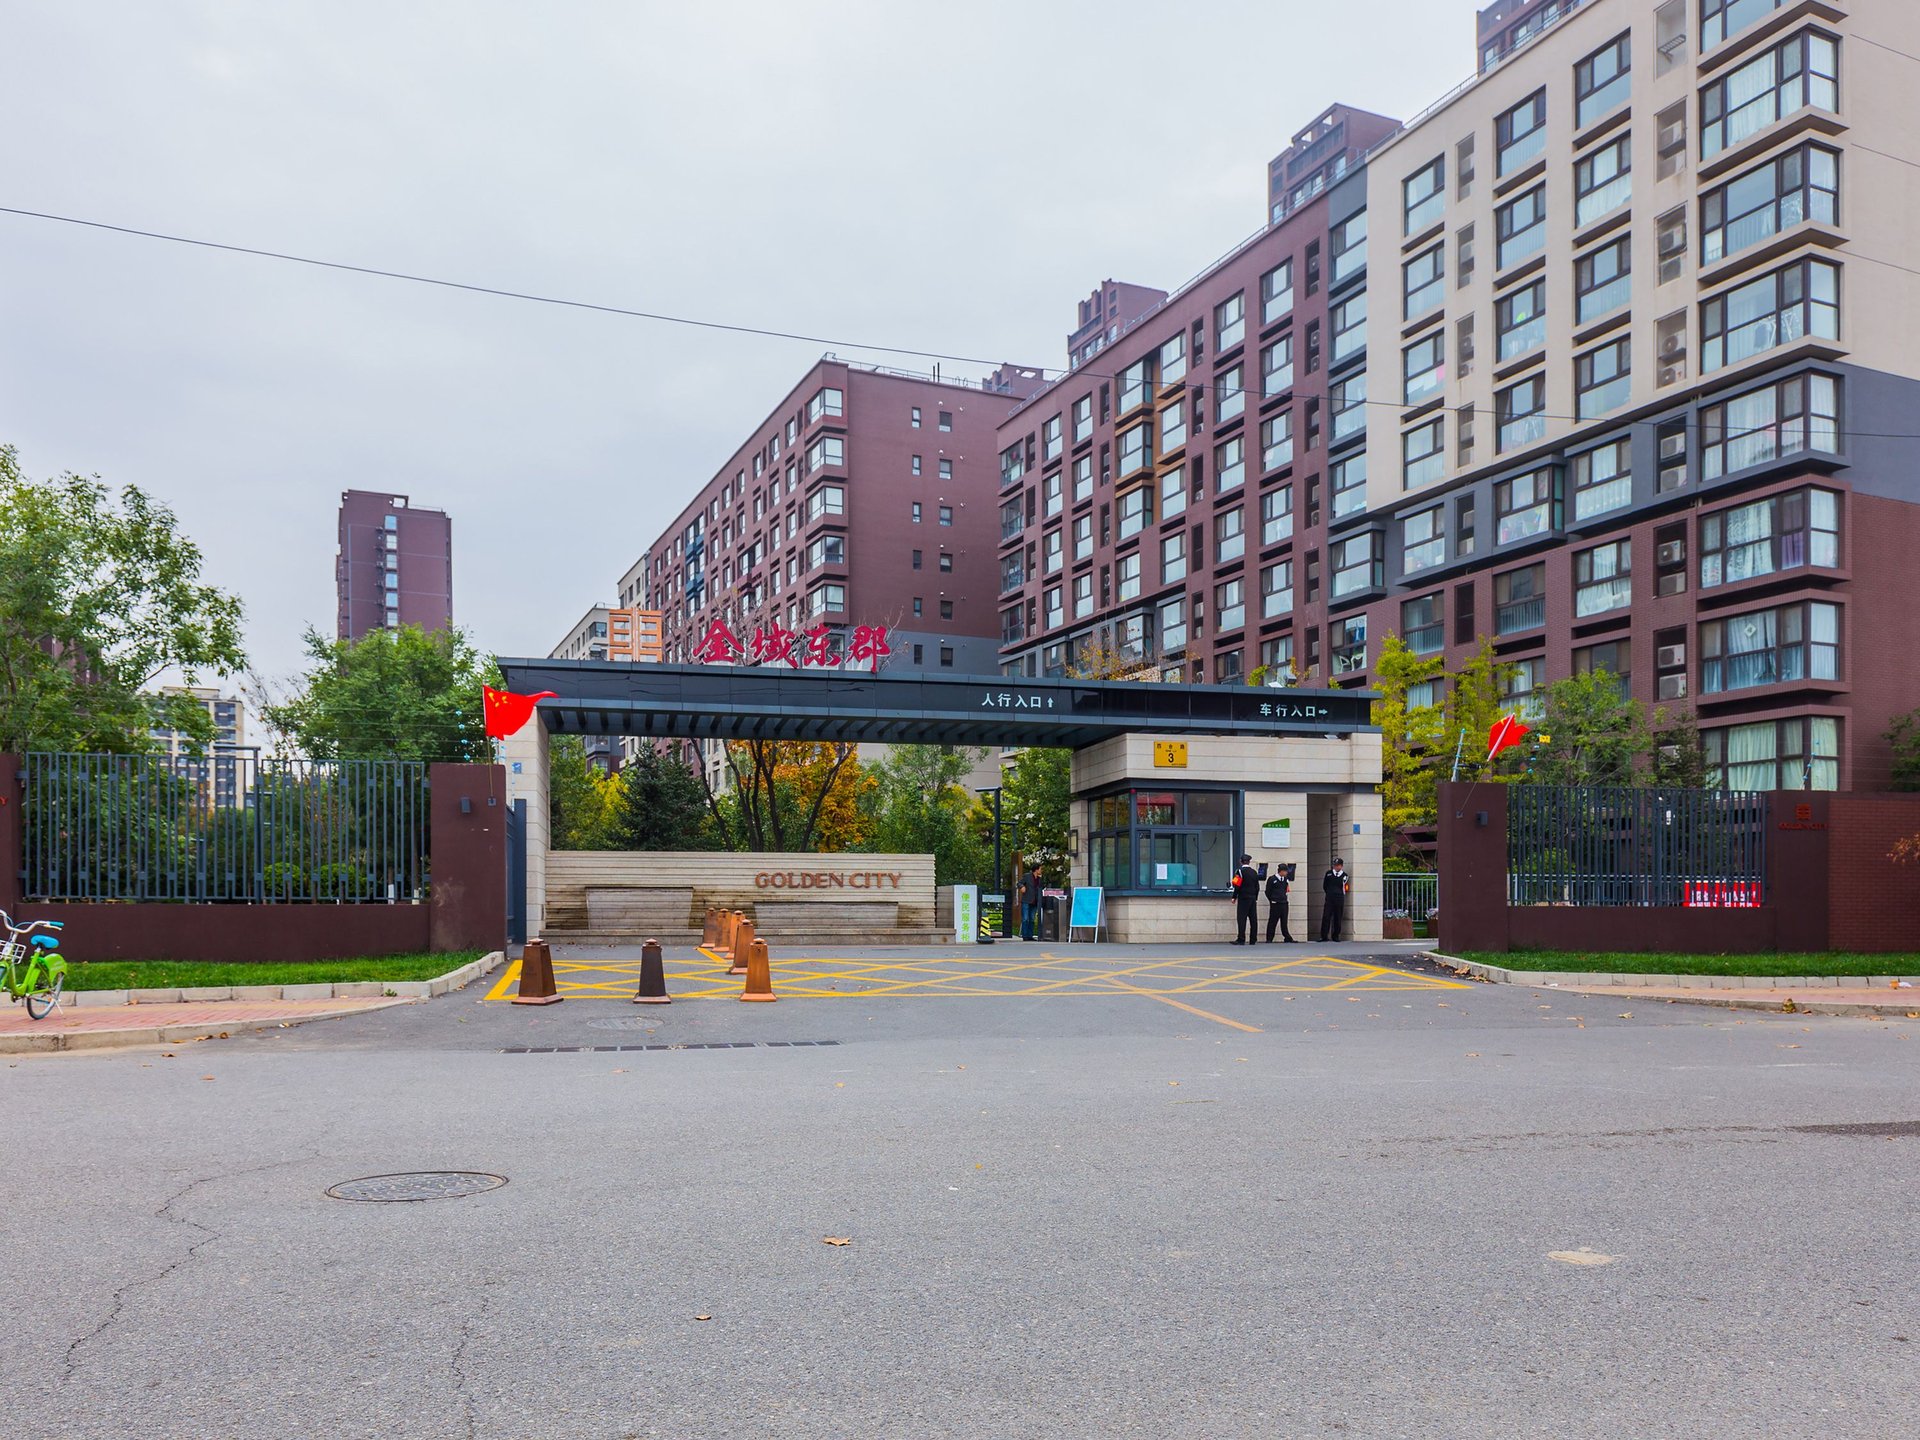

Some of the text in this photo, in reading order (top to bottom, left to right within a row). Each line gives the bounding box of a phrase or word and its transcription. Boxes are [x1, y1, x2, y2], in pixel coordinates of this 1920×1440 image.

[693, 618, 891, 674] 金域东郡
[981, 692, 1042, 709] 人行入口
[1259, 702, 1316, 718] 车行入口
[1168, 752, 1174, 763] 3
[754, 871, 902, 889] GOLDEN CITY
